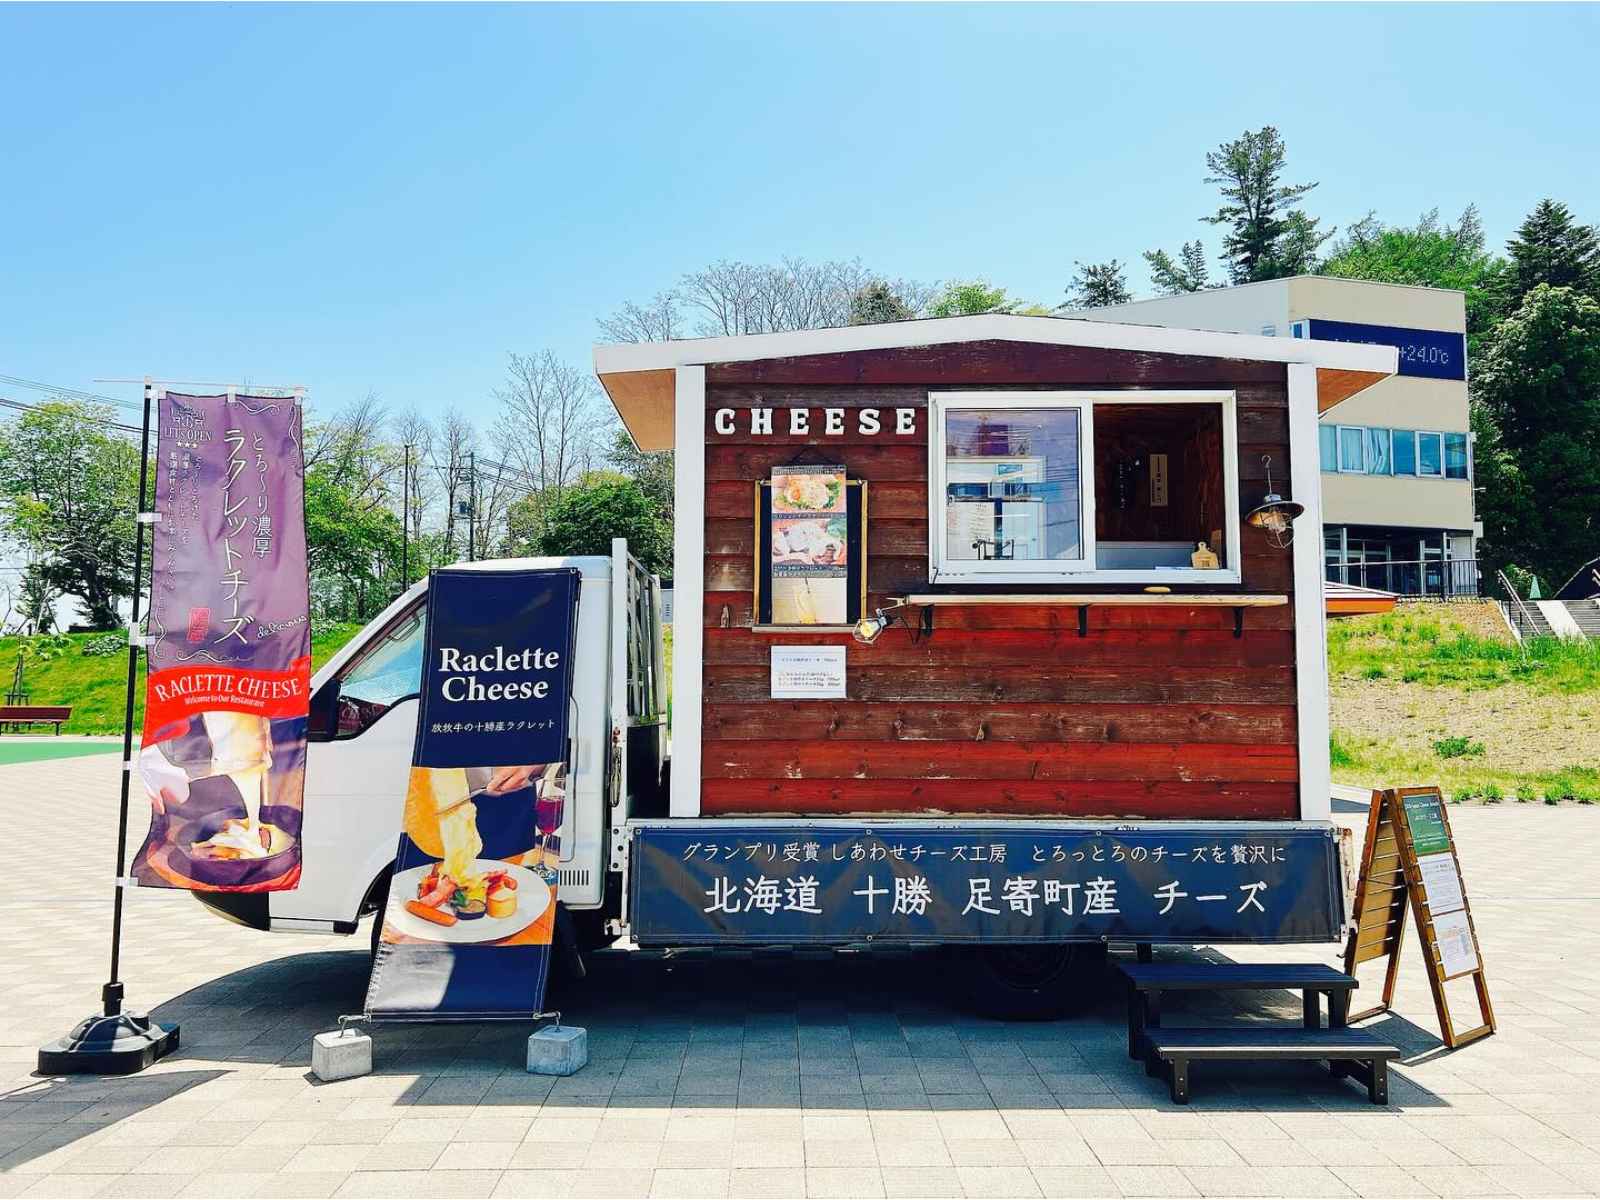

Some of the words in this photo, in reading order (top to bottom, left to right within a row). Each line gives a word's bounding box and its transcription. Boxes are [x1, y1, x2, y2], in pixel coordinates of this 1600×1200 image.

[714, 408, 916, 435] CHEESE
[214, 429, 254, 645] ラクレットチーズ
[438, 646, 559, 672] Raclette
[155, 673, 235, 702] RACLETTE
[238, 677, 302, 699] CHEESE
[441, 676, 549, 702] Cheese
[683, 841, 821, 862] グランプリ受賞
[831, 843, 1008, 864] しあわせチーズ工房
[1032, 844, 1287, 865] とろっとろのチーズを贅沢に
[703, 875, 823, 916] 北海道
[853, 875, 933, 916] 十勝
[961, 875, 1121, 917] 足寄町産
[1152, 880, 1269, 916] チーズ
